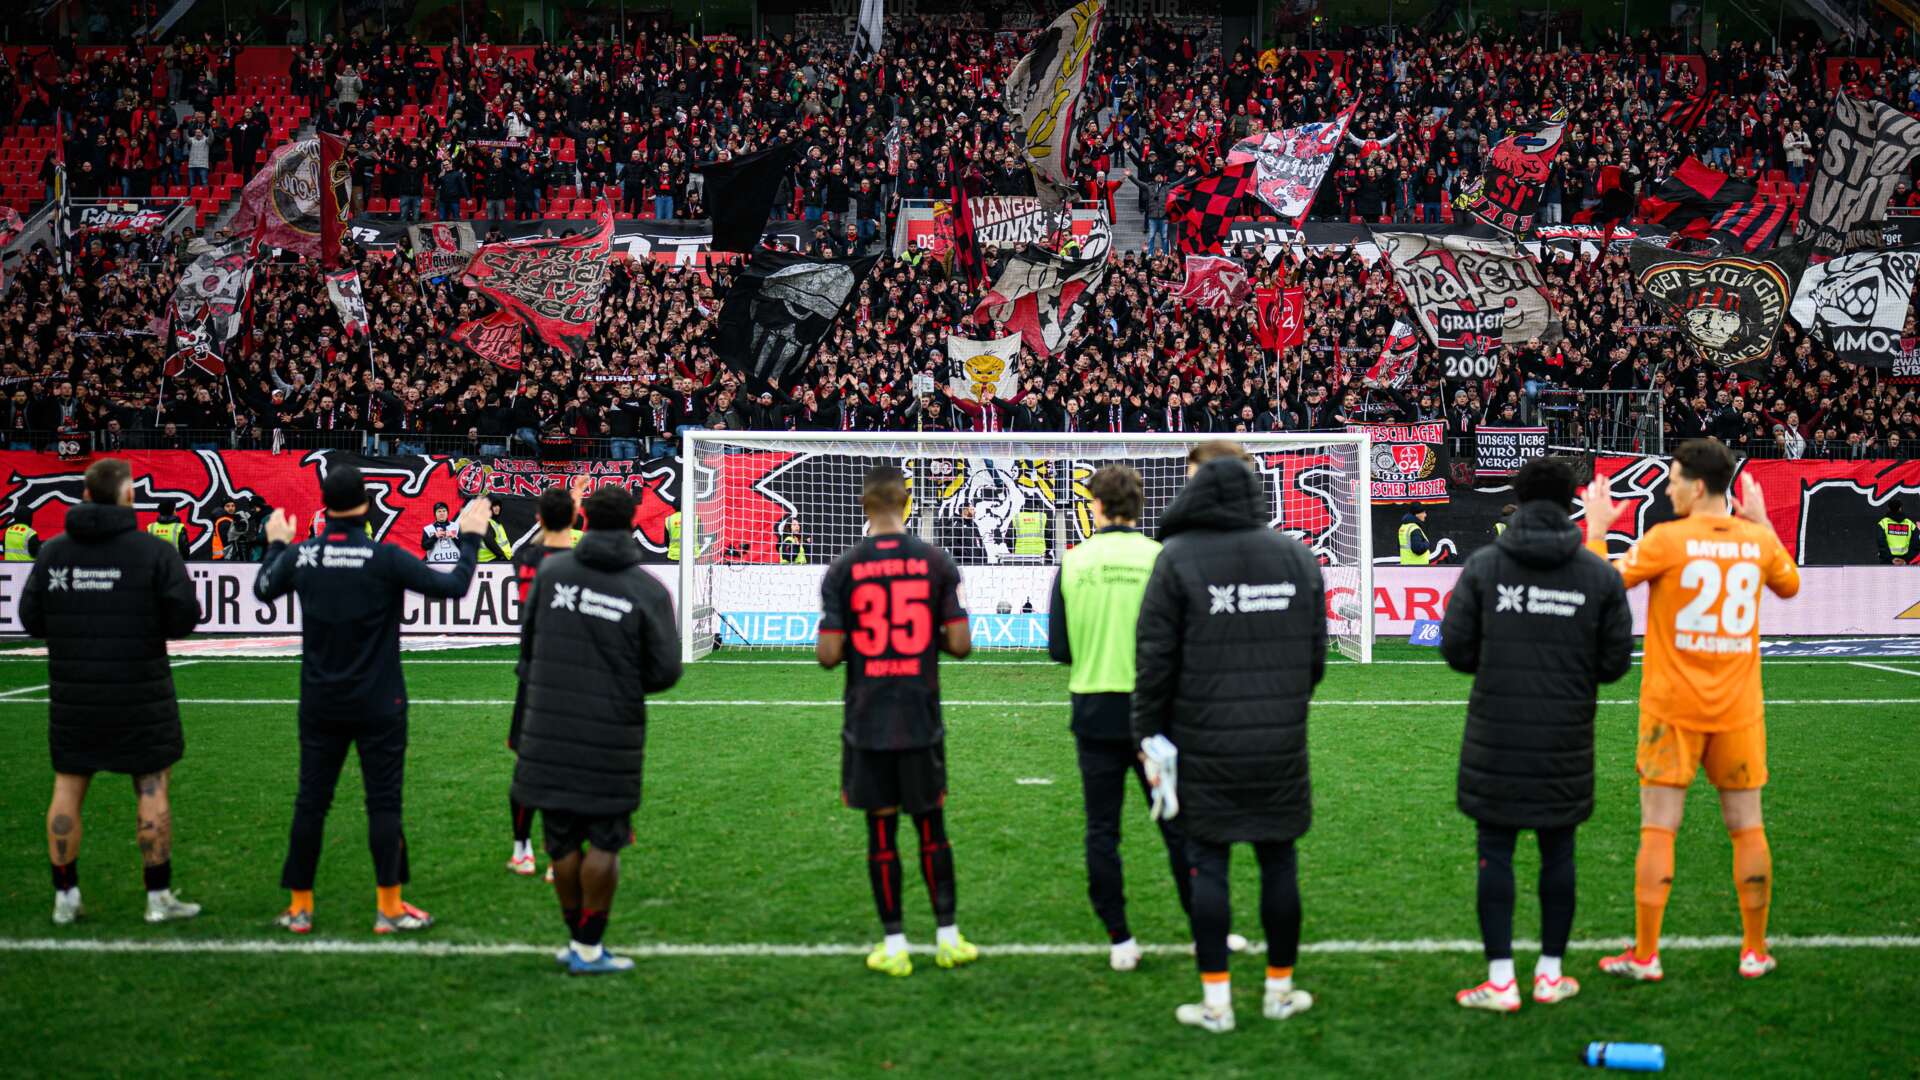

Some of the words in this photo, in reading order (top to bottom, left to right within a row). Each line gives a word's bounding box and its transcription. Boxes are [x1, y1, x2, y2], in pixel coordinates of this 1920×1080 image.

[1444, 353, 1499, 377] 2009
[1477, 434, 1517, 446] UNSERE
[1519, 433, 1546, 446] LIEBE
[1477, 445, 1516, 457] WIRD
[1520, 447, 1545, 457] NIE
[1477, 456, 1528, 469] VERGEH
[1408, 477, 1448, 496] MEISTER
[1685, 539, 1739, 560] BAYER
[1742, 541, 1761, 560] 04
[906, 558, 929, 576] 04
[193, 570, 241, 625] ÜR
[1674, 559, 1762, 636] 28
[850, 579, 933, 658] 35
